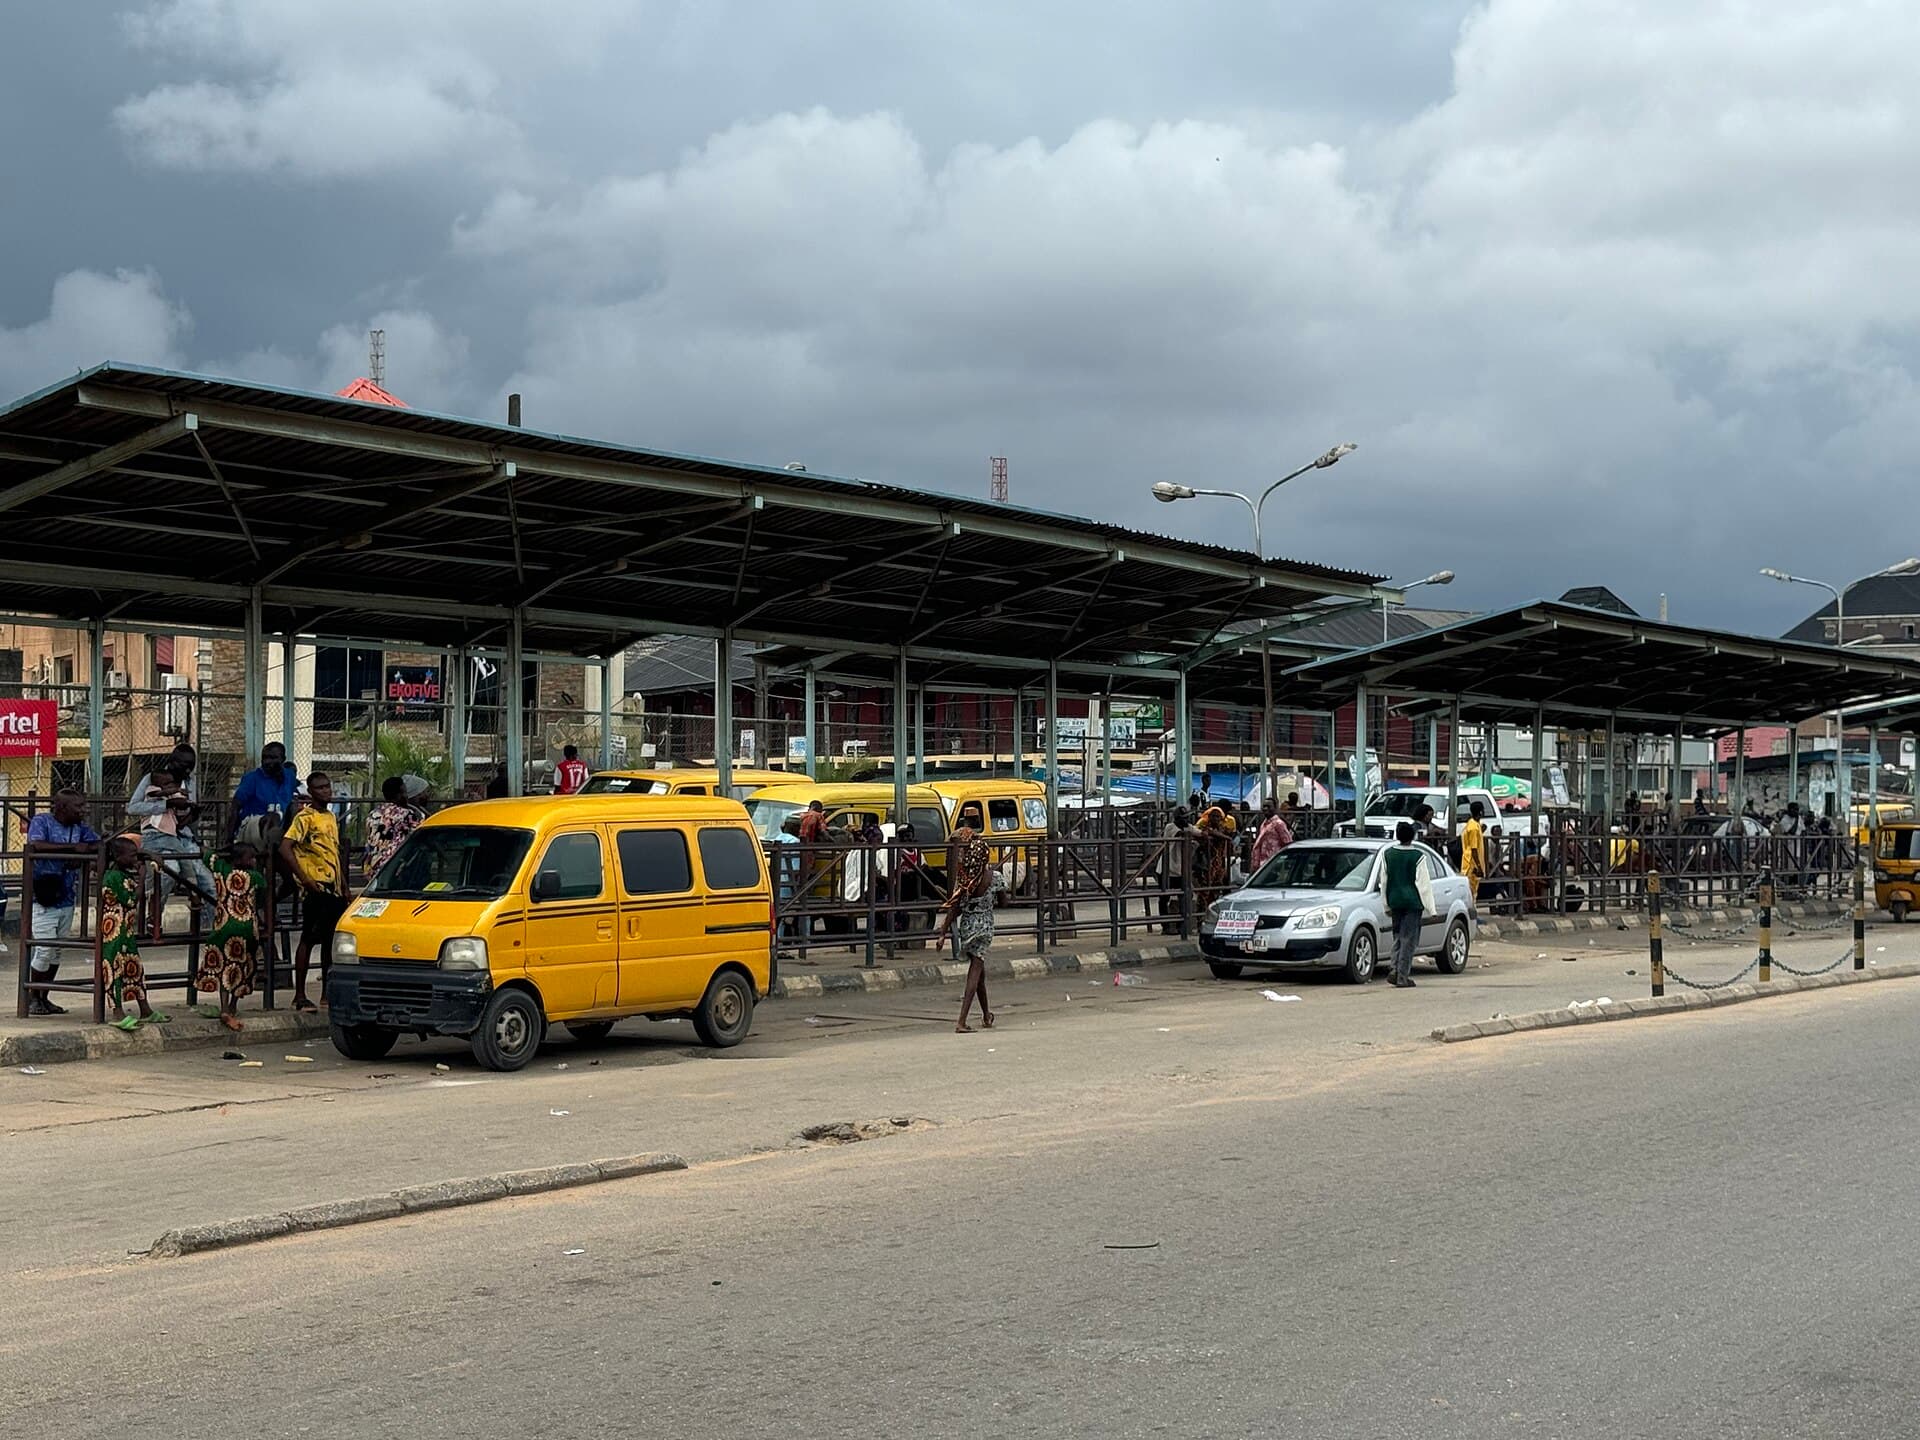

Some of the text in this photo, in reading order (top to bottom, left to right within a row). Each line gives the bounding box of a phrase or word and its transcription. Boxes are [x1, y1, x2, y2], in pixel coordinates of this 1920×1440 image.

[389, 683, 440, 699] EKOFIVE
[0, 712, 41, 734] rtel
[5, 738, 41, 747] IMAGINE
[569, 768, 584, 788] 17
